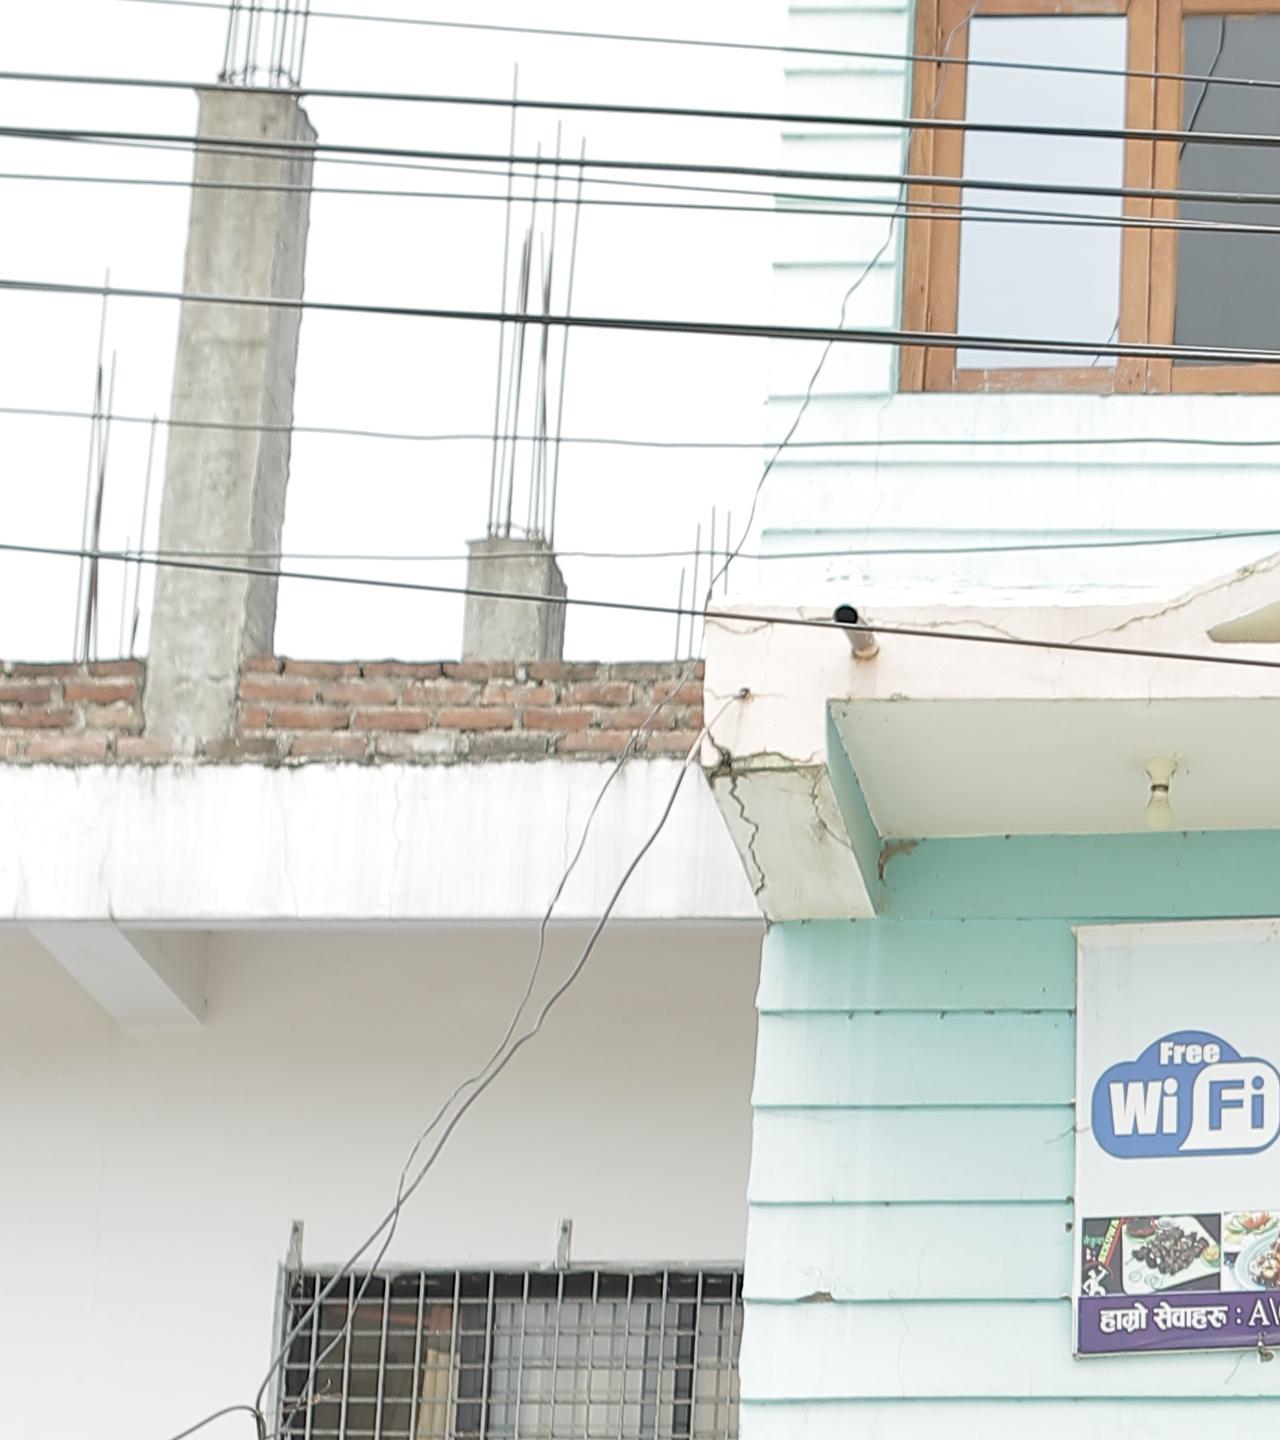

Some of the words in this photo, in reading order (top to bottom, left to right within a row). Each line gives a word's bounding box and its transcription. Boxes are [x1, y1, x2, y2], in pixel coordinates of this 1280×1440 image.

[1160, 1042, 1220, 1064] Free
[1110, 1081, 1177, 1135] Wi
[1206, 1072, 1268, 1132] Fi
[1100, 1303, 1148, 1332] हाम्रो
[1153, 1302, 1228, 1330] सेवाहरू
